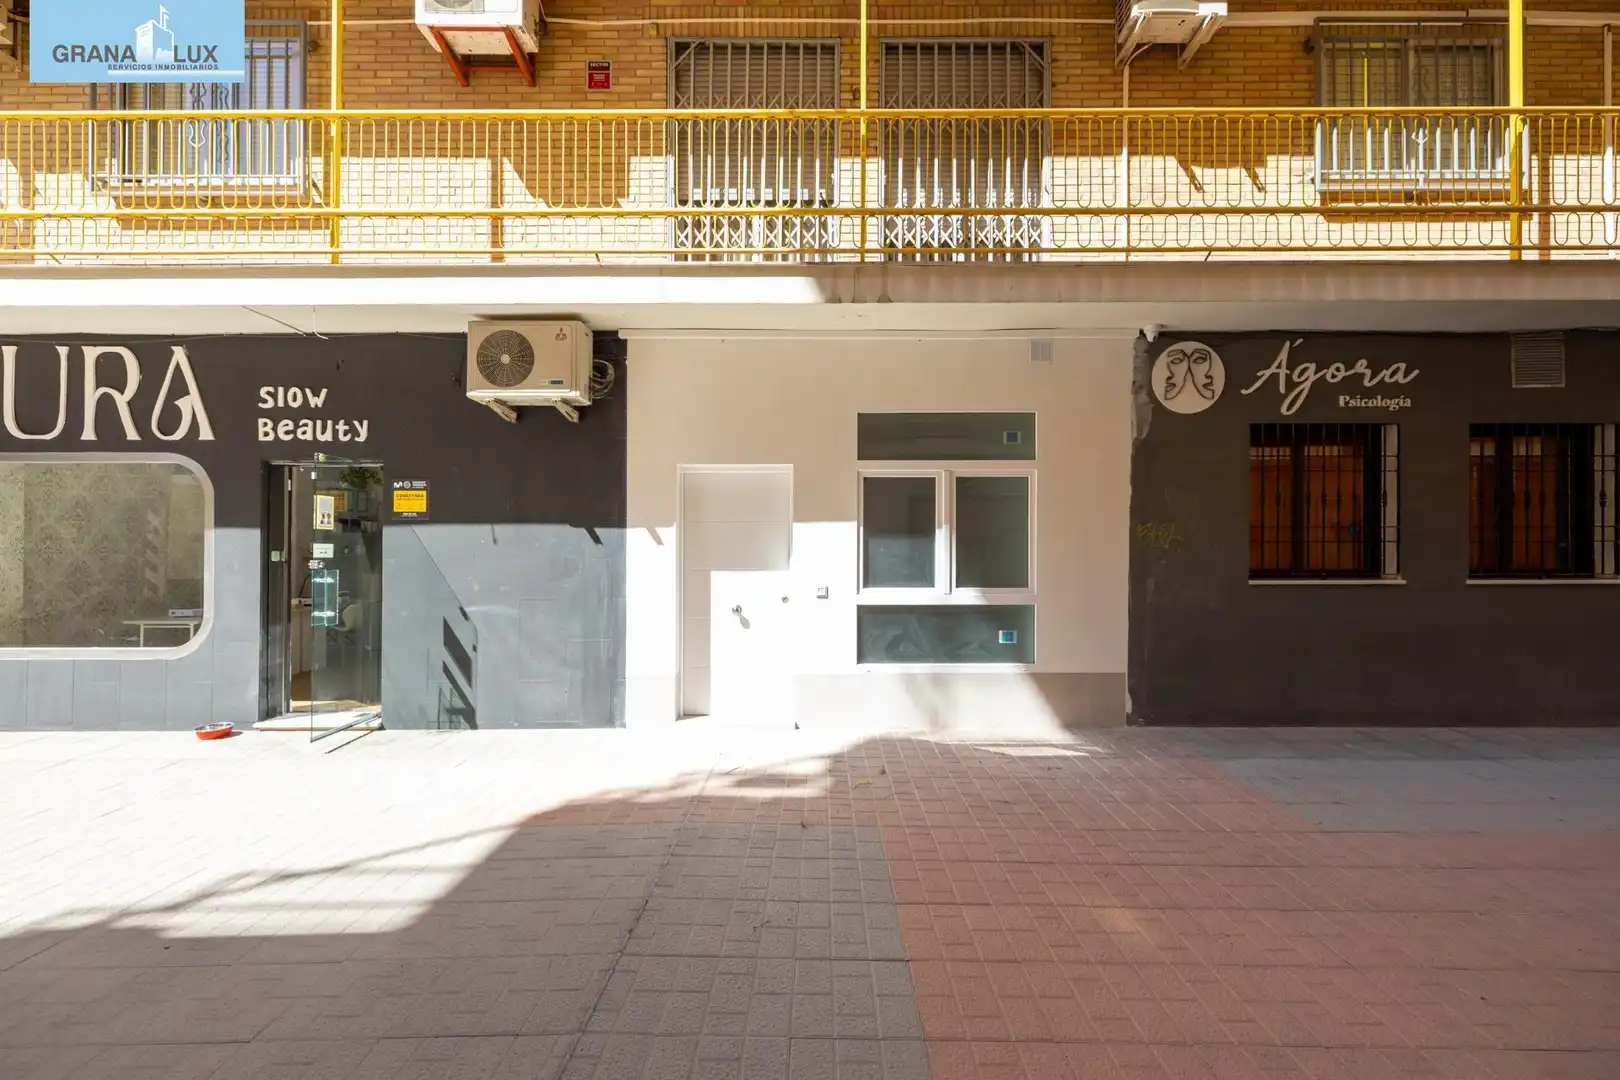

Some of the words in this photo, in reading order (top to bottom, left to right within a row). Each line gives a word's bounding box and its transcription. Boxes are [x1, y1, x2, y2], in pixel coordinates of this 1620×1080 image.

[1, 345, 215, 441] URA
[1240, 338, 1420, 416] Ágora
[1338, 395, 1412, 411] Psicología
[257, 417, 369, 443] Beauty
